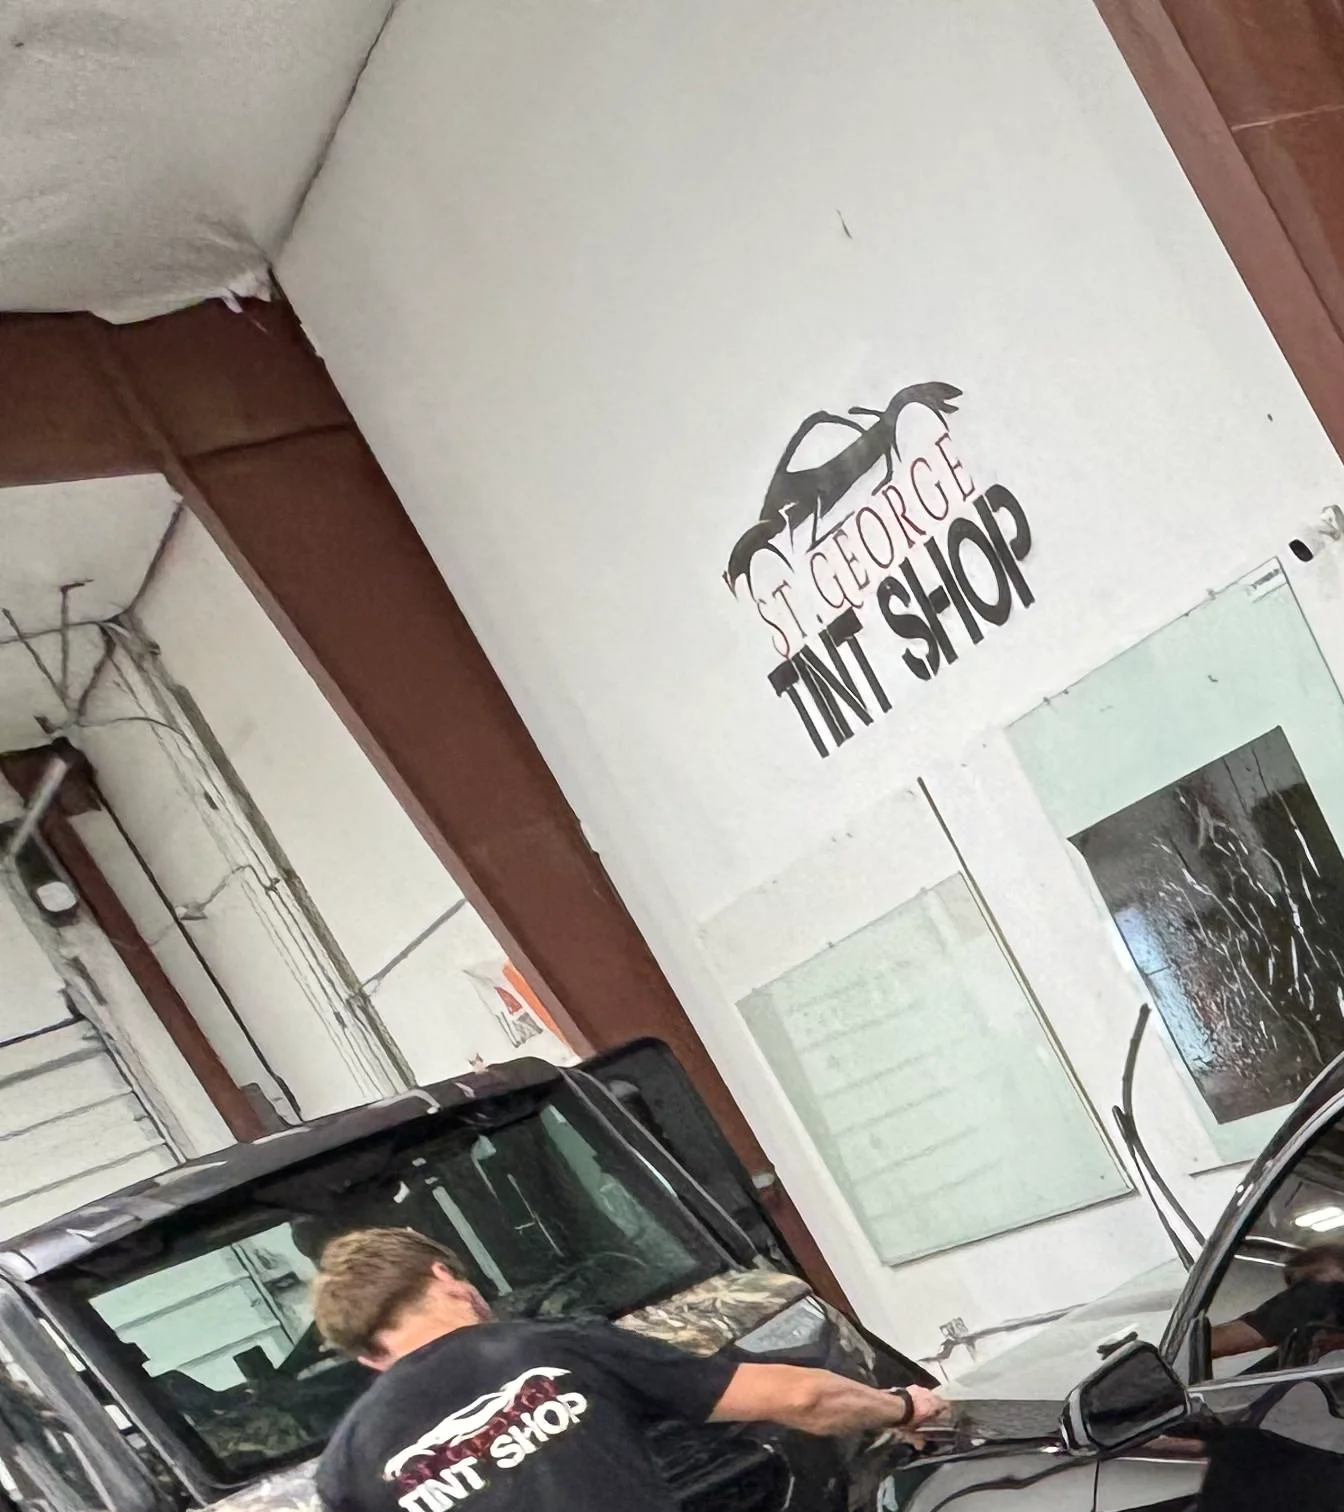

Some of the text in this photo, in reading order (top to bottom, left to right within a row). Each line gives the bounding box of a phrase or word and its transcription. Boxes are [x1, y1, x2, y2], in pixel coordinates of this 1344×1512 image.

[810, 432, 976, 609] GEORGE
[767, 483, 1035, 759] TINT SHOP
[490, 1392, 588, 1469] SHOP
